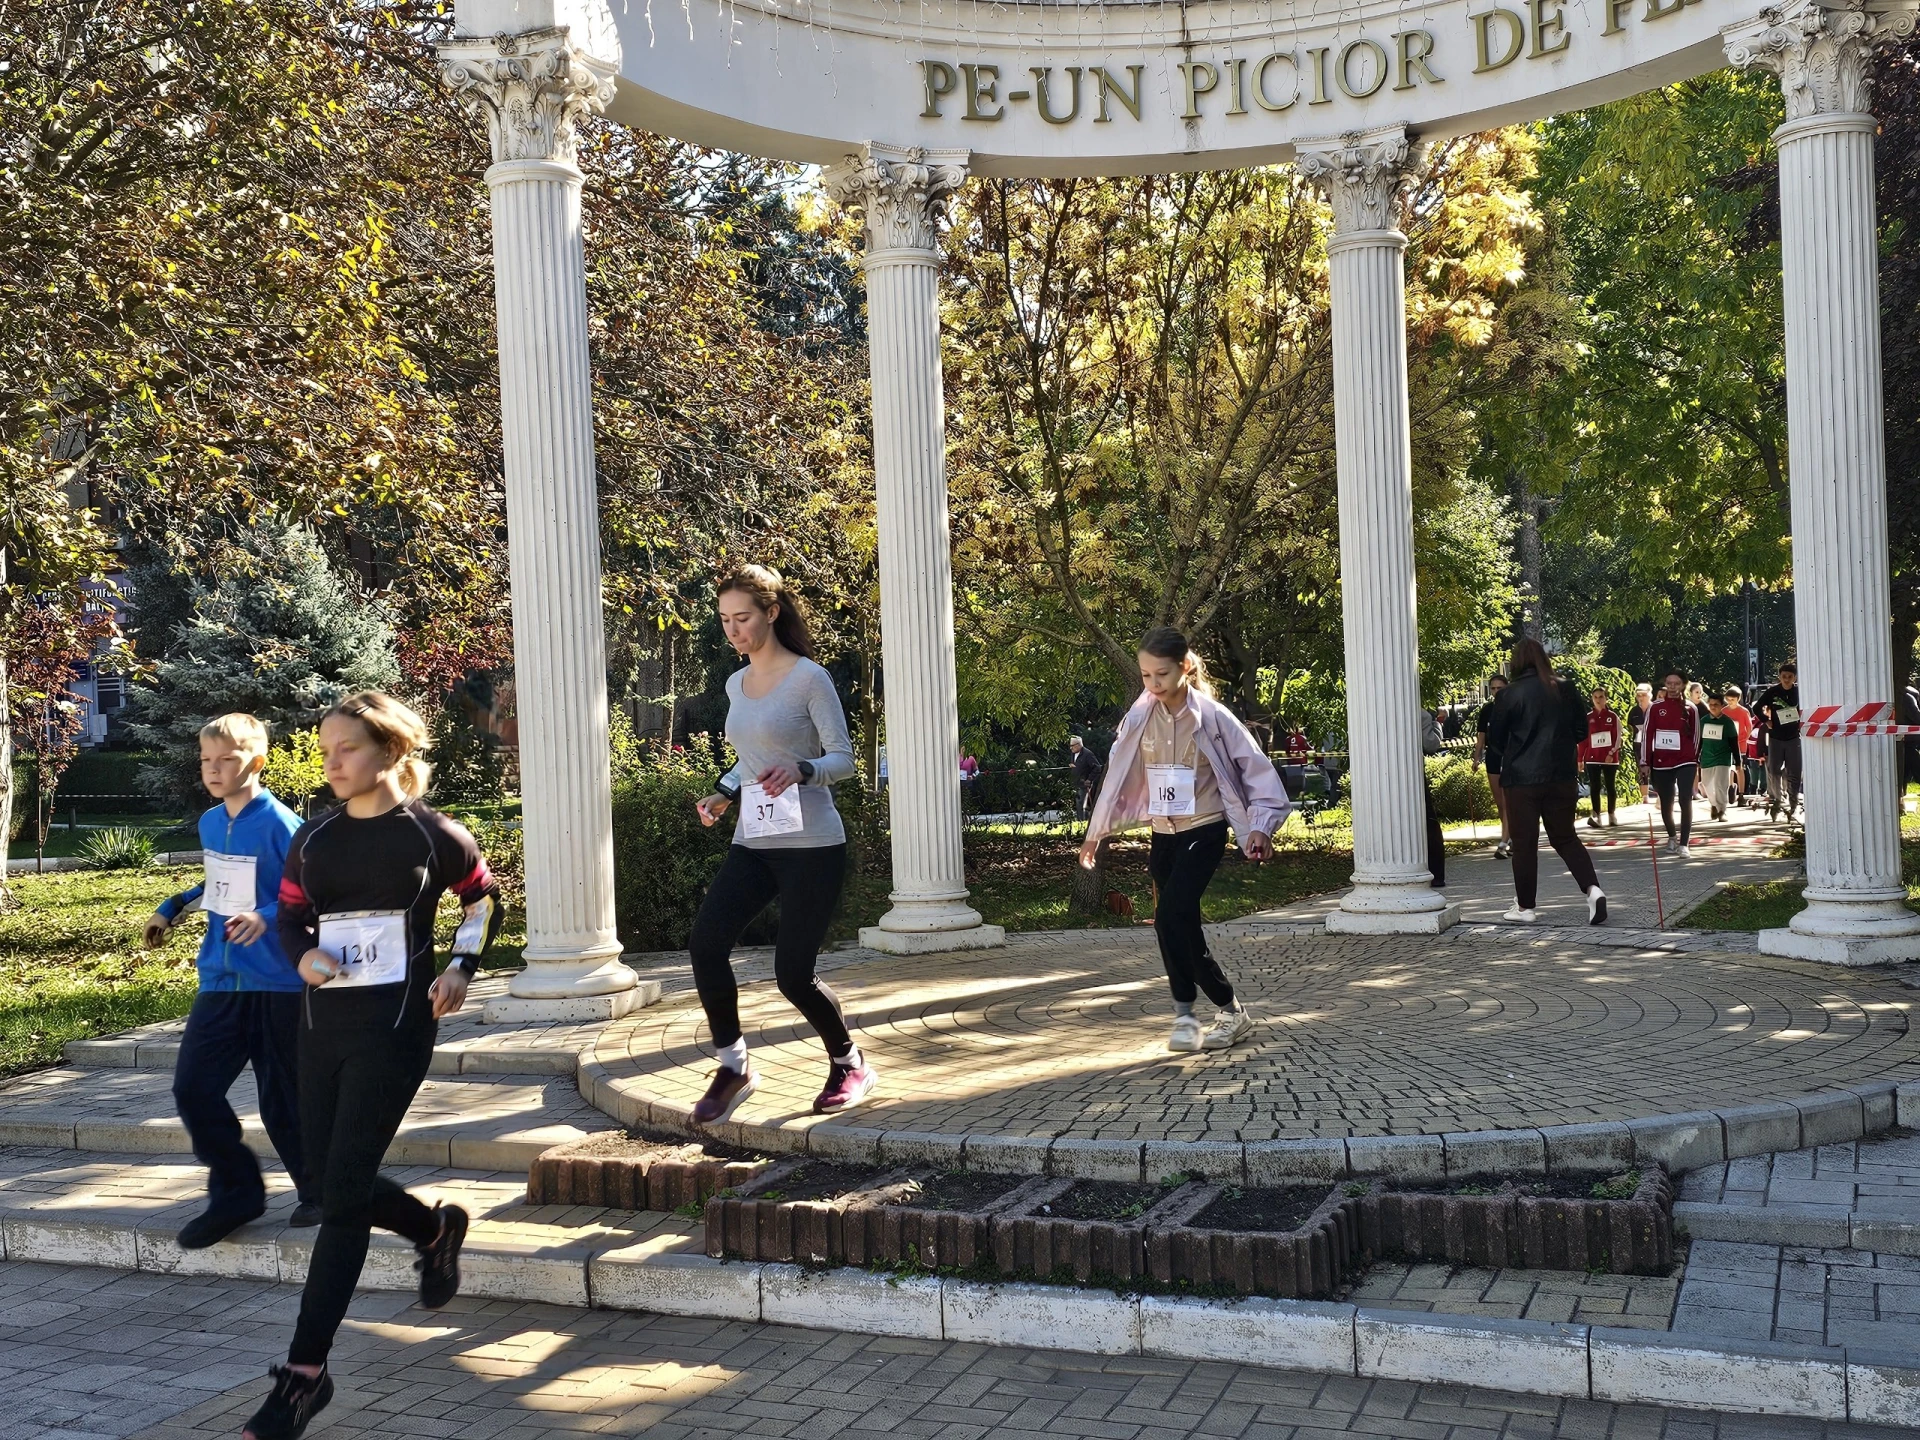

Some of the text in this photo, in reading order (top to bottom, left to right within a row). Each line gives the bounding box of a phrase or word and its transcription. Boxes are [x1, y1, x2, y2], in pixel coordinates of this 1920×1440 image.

[916, 60, 1145, 125] PE-UN
[1177, 29, 1446, 119] PICIOR
[1469, 0, 1572, 75] DE
[756, 803, 774, 821] 37
[215, 881, 230, 898] 57
[340, 944, 378, 966] 120
